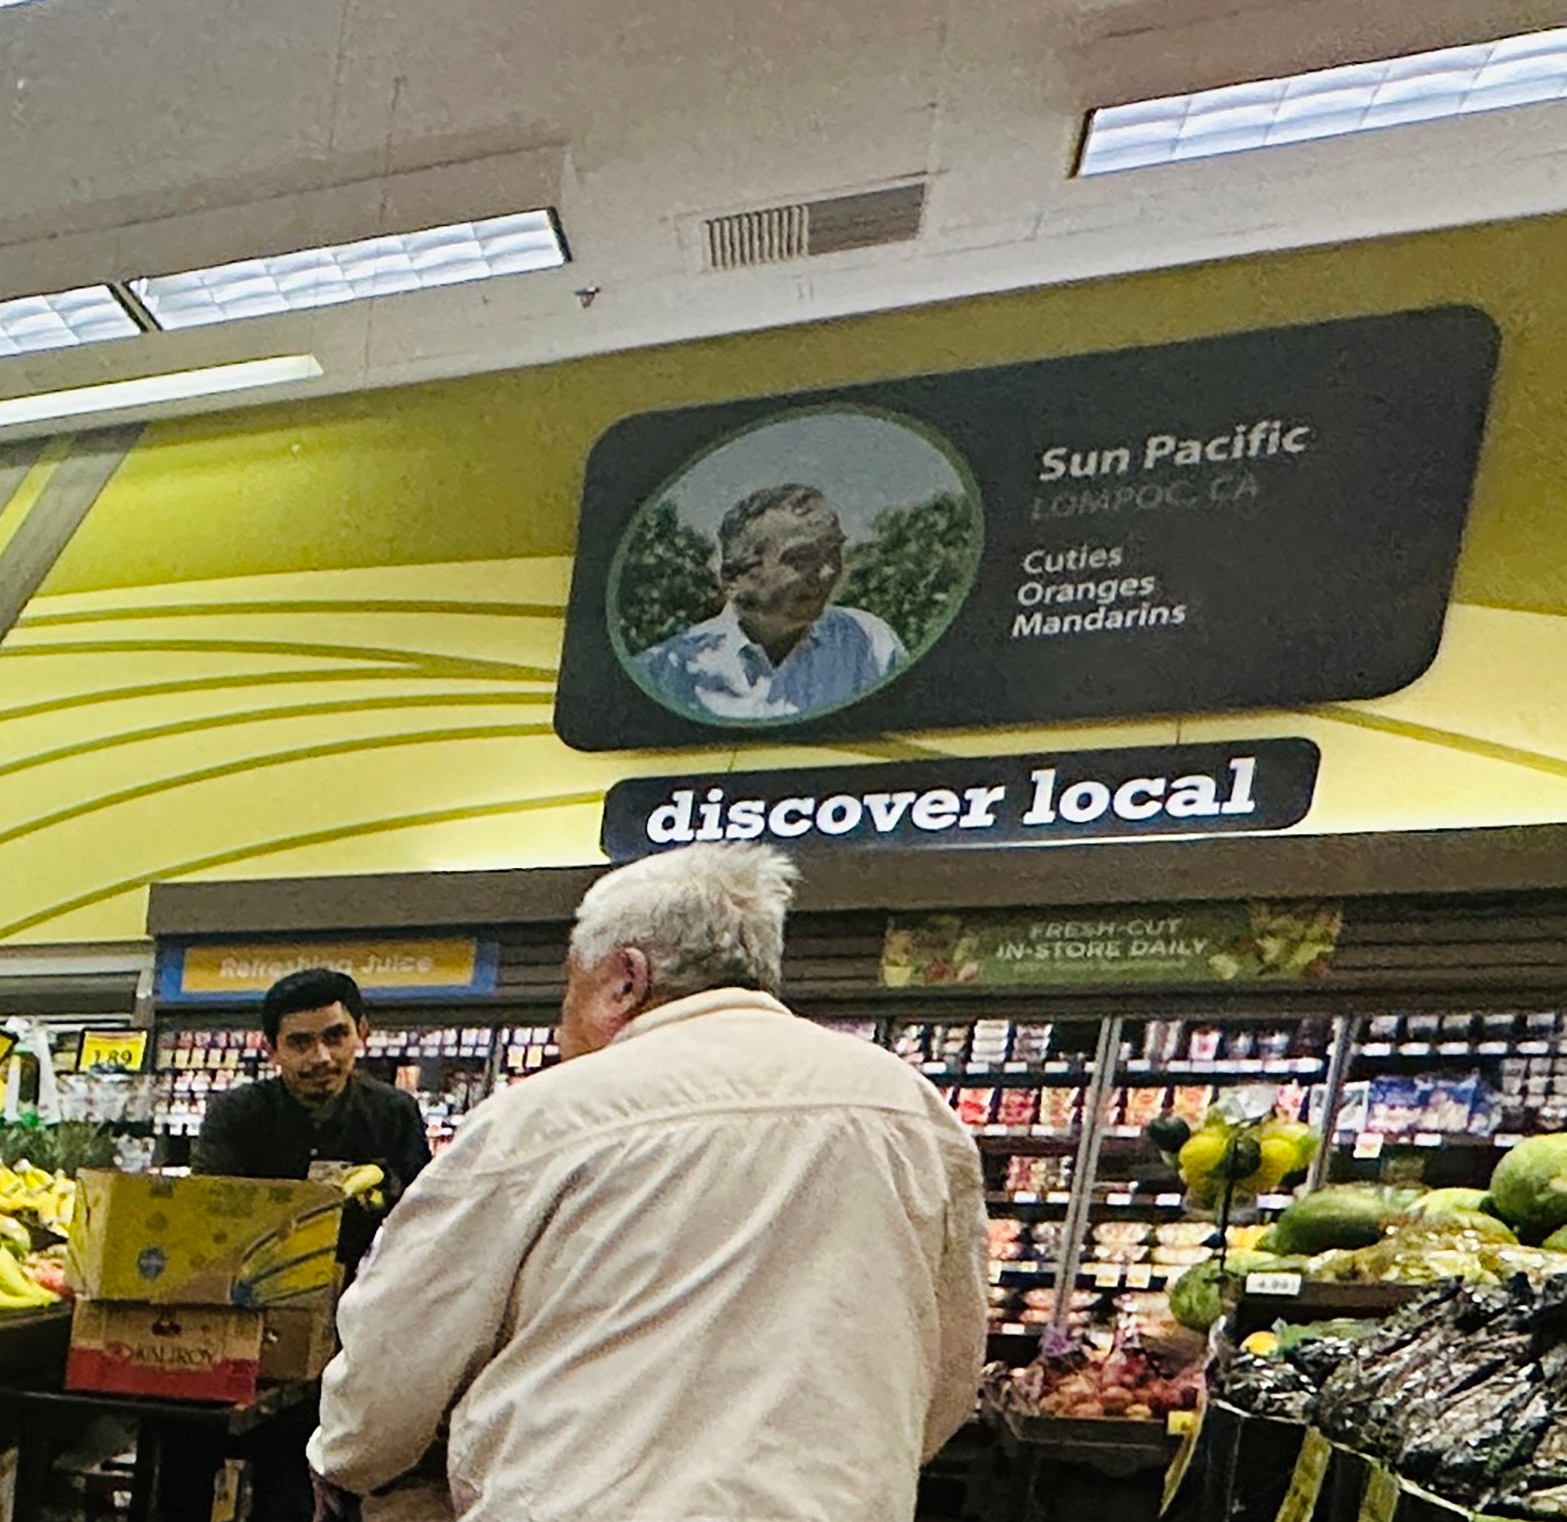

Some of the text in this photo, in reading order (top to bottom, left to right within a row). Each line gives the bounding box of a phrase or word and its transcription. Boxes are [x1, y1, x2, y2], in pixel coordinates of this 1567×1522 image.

[1039, 418, 1313, 485] Sun Pacific
[1209, 472, 1260, 505] CA
[1022, 540, 1125, 578] Cuties
[1016, 570, 1156, 613] Oranges
[1011, 600, 1188, 641] Mandarins
[645, 757, 1259, 849] discover local
[1028, 918, 1184, 941] FRESH-CUT
[357, 953, 435, 976] Juice
[996, 936, 1210, 963] IN-STORE DAILY
